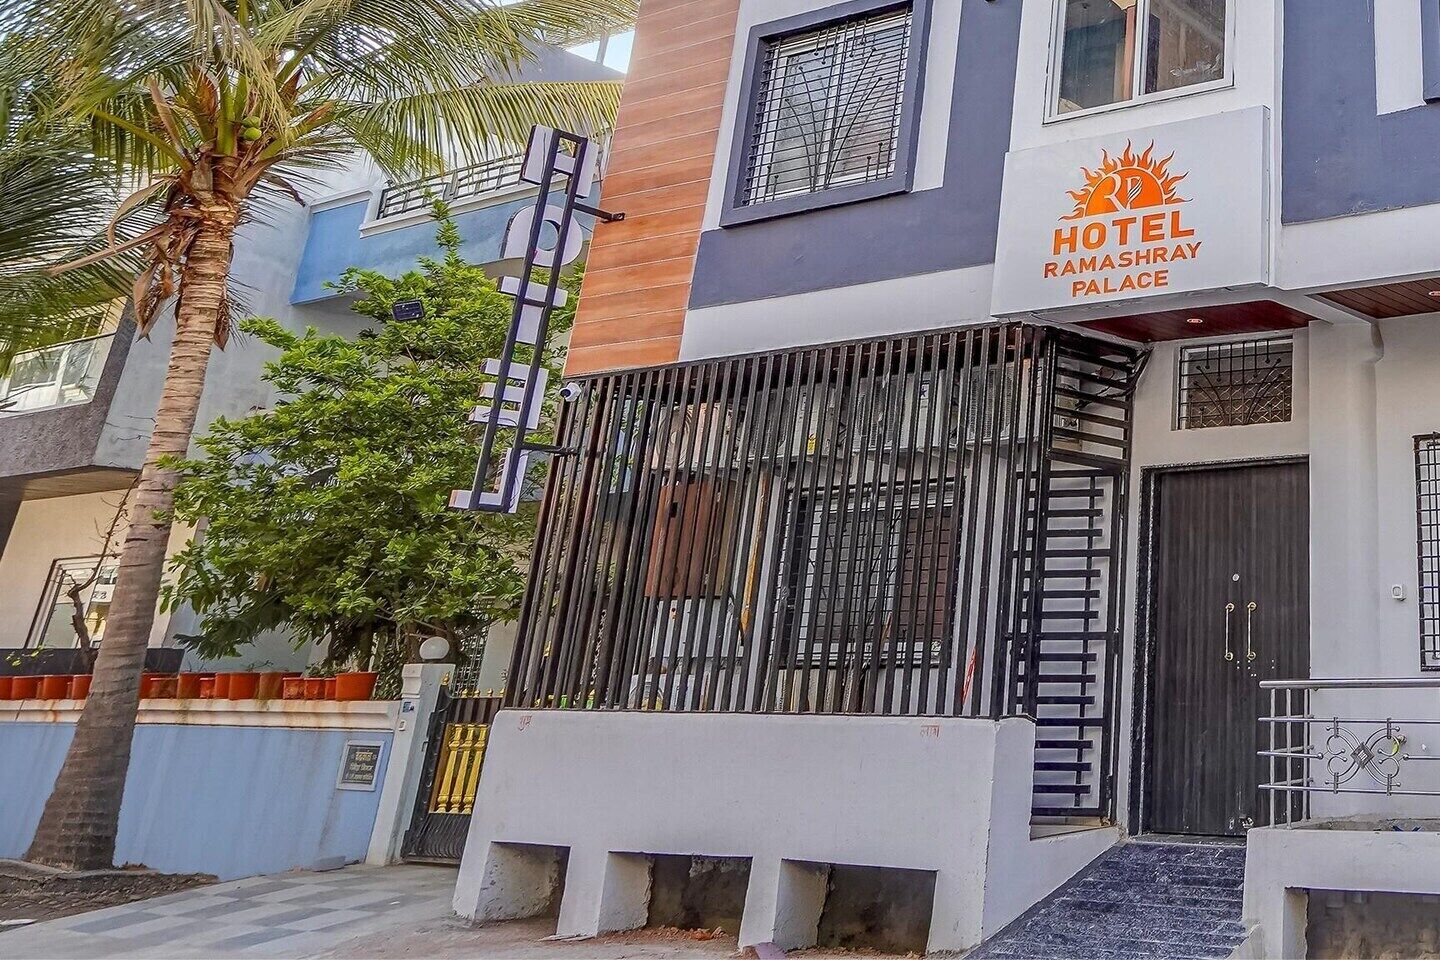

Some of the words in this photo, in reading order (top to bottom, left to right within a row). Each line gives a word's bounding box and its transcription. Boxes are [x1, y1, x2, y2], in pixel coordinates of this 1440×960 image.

[1051, 209, 1195, 257] HOTEL
[1043, 241, 1203, 279] RAMASHRAY
[1072, 269, 1169, 298] PALACE
